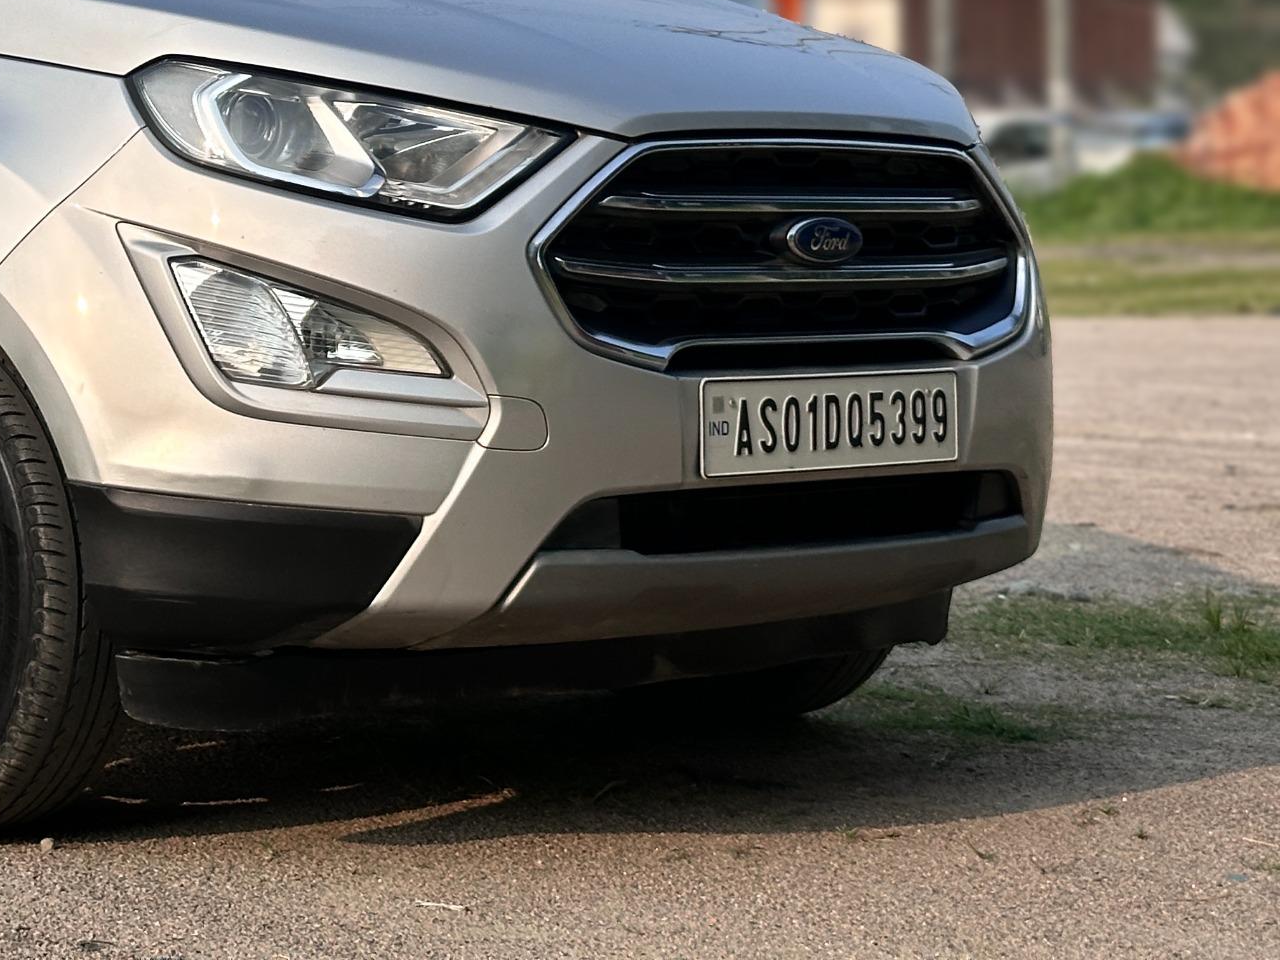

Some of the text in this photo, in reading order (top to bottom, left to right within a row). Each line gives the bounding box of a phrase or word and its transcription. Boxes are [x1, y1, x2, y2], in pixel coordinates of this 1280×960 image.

[810, 225, 850, 251] Ford
[708, 420, 730, 436] IND
[734, 387, 948, 457] AS01DQ5399
